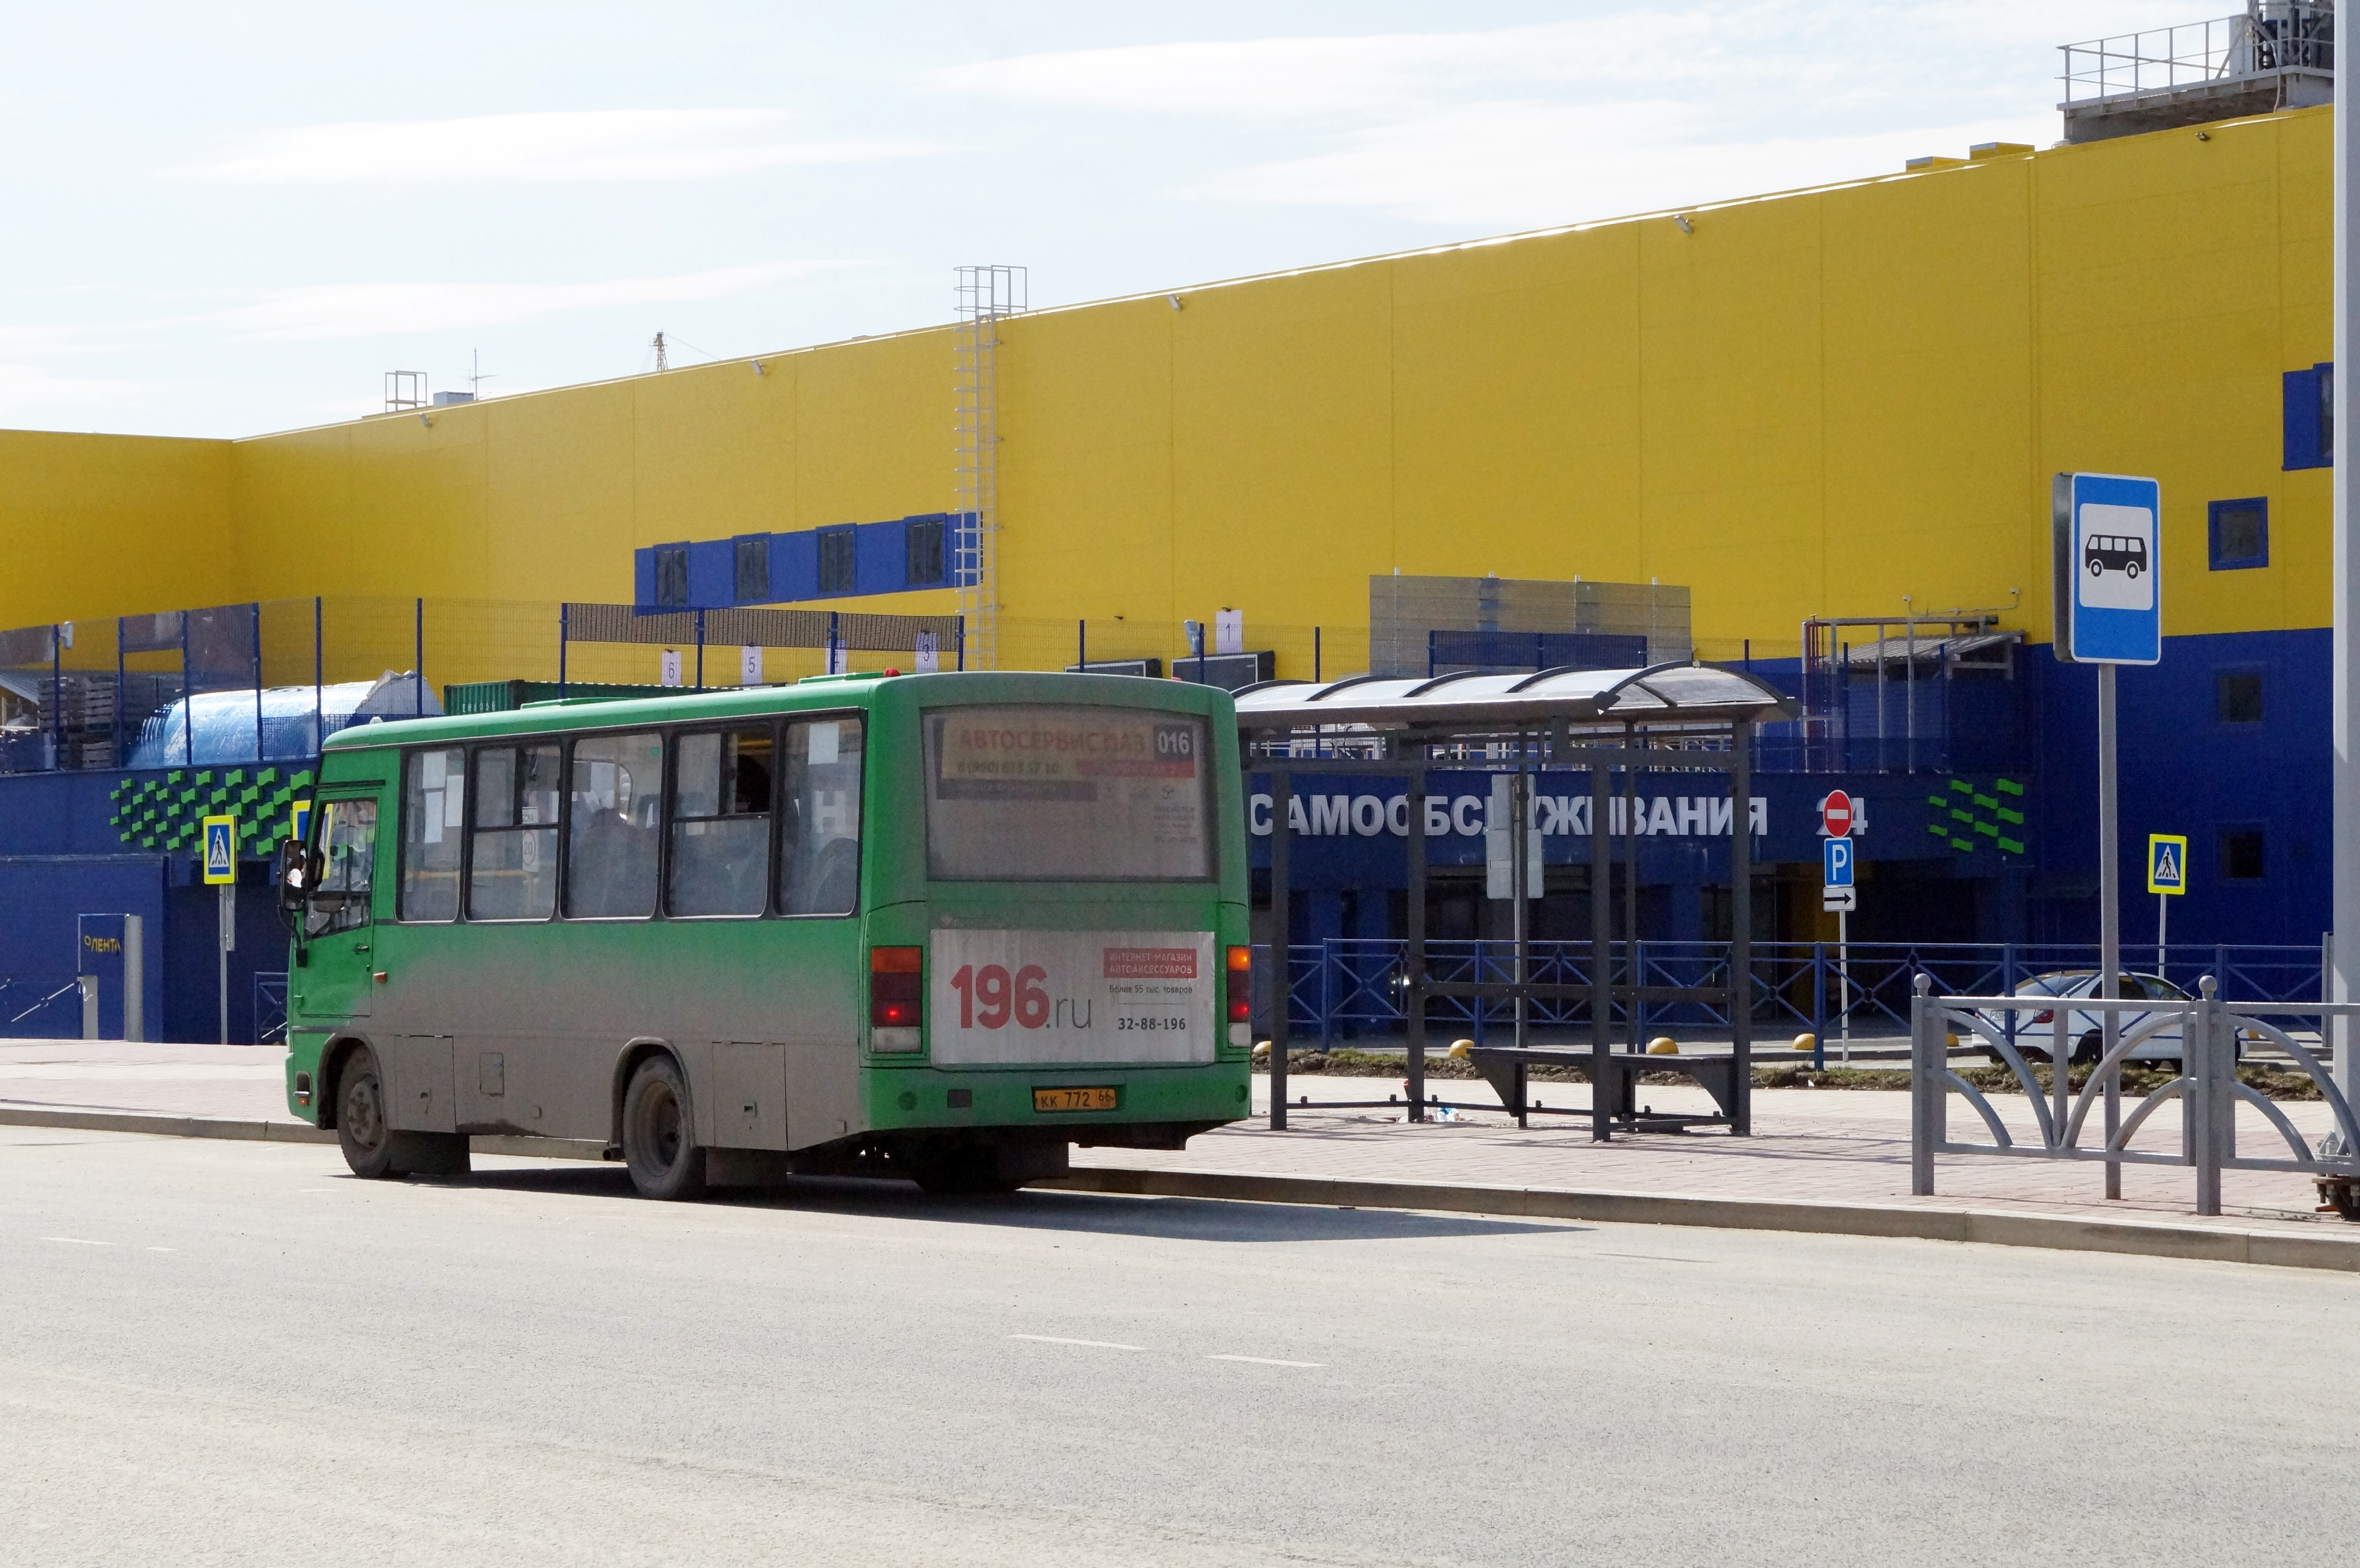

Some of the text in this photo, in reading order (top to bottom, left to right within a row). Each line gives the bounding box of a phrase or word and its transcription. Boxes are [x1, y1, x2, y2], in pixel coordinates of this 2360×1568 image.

[1226, 623, 1230, 641] 1
[668, 662, 674, 679] 6
[749, 656, 755, 673] 5
[960, 729, 1099, 753] АВТОСЕРВИС
[1158, 732, 1190, 754] 016
[1832, 845, 1847, 881] P
[1109, 965, 1192, 974] АВТОАКСЕССУАРОВ
[950, 964, 1092, 1029] 196.ru
[1109, 985, 1132, 993] Более
[1134, 985, 1143, 994] 55
[1163, 986, 1192, 995] товаров
[1118, 1017, 1186, 1030] 32-88-196
[1065, 1091, 1090, 1107] 772
[1098, 1090, 1114, 1102] 66
